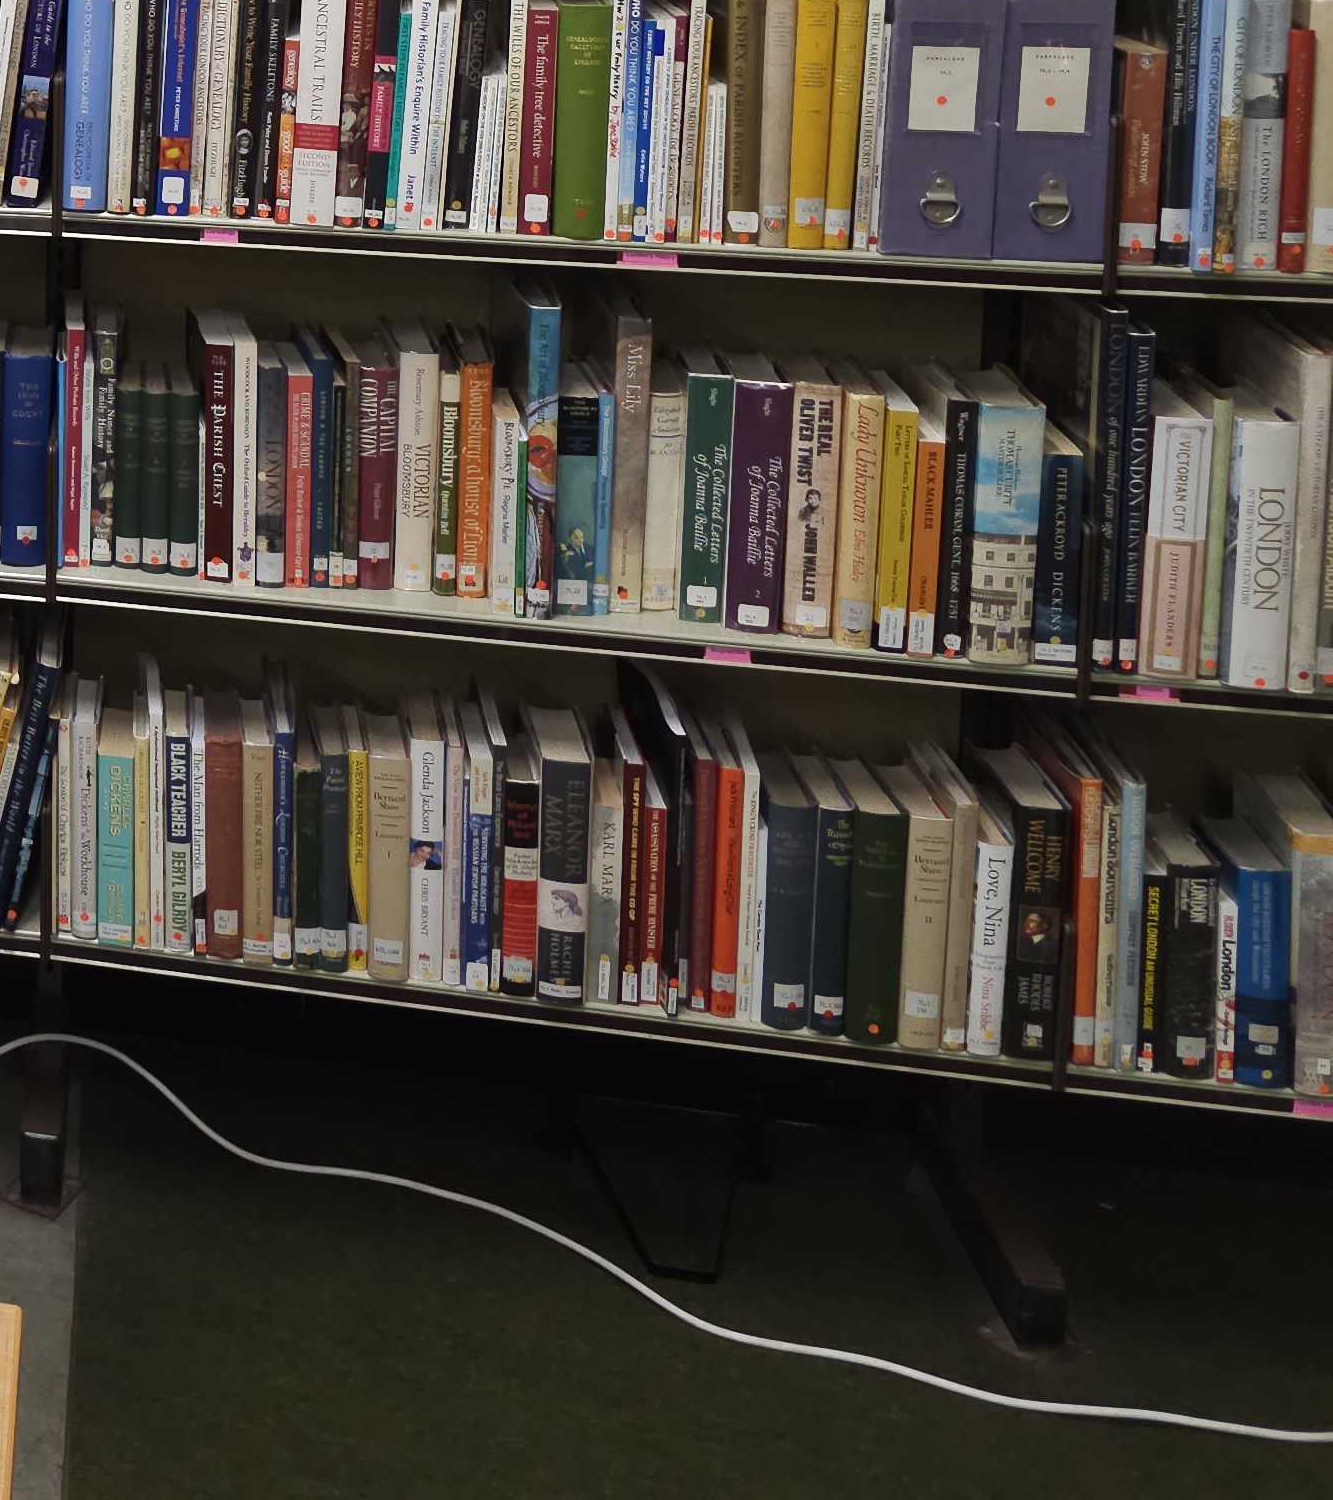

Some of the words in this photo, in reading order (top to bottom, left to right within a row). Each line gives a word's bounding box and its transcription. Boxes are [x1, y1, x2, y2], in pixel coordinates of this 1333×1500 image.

[419, 3, 430, 33] Family
[416, 35, 427, 84] Historian's
[537, 34, 549, 54] The
[535, 55, 548, 92] family
[311, 74, 324, 121] TRAILS
[412, 86, 422, 122] Enquire
[534, 92, 545, 112] tree
[409, 124, 420, 156] Within
[532, 114, 545, 158] detective
[1263, 126, 1272, 145] The
[1259, 152, 1270, 205] LONDON
[1257, 208, 1268, 240] RICH
[627, 344, 643, 379] Miss
[214, 370, 224, 398] THE
[621, 384, 641, 414] Lily
[211, 403, 227, 457] PARISH
[359, 378, 379, 458] COMPANION
[379, 397, 395, 455] CAPITAL
[799, 398, 815, 442] OLIVER
[818, 400, 833, 422] THE
[439, 406, 458, 487] Bloomsbury
[693, 453, 706, 466] of
[713, 444, 726, 465] The
[817, 423, 832, 456] REAL
[212, 461, 225, 506] CHEST
[401, 444, 412, 518] BLOOMSBURY
[413, 443, 431, 519] VICTORIAN
[797, 446, 813, 486] TWIST
[1057, 467, 1068, 505] PETER
[1175, 441, 1191, 504] VICTORIAN
[695, 468, 709, 512] Joanna
[711, 467, 724, 519] Collected
[694, 514, 707, 552] Baillie
[1055, 506, 1067, 561] ACKROYD
[1172, 504, 1185, 533] CITY
[710, 525, 722, 564] Letters
[803, 524, 818, 557] JOHN
[1254, 487, 1286, 613] LONDON
[802, 558, 817, 601] WALLER
[1051, 571, 1063, 632] DICKENS
[171, 743, 186, 782] BLACK
[194, 752, 204, 771] The
[422, 751, 434, 791] Glenda
[194, 775, 202, 797] Man
[171, 786, 186, 837] TEACHER
[193, 800, 204, 825] from
[420, 793, 432, 834] Jackson
[172, 851, 186, 887] BERYL
[193, 829, 203, 869] Harrods
[1024, 819, 1046, 894] WELLCOME
[1043, 836, 1062, 883] HENRY
[421, 877, 429, 906] CHRIS
[983, 857, 1006, 901] Love,
[172, 891, 187, 932] GILROY
[420, 906, 429, 937] BRYANT
[983, 905, 1003, 947] Nina
[1220, 940, 1235, 990] London
